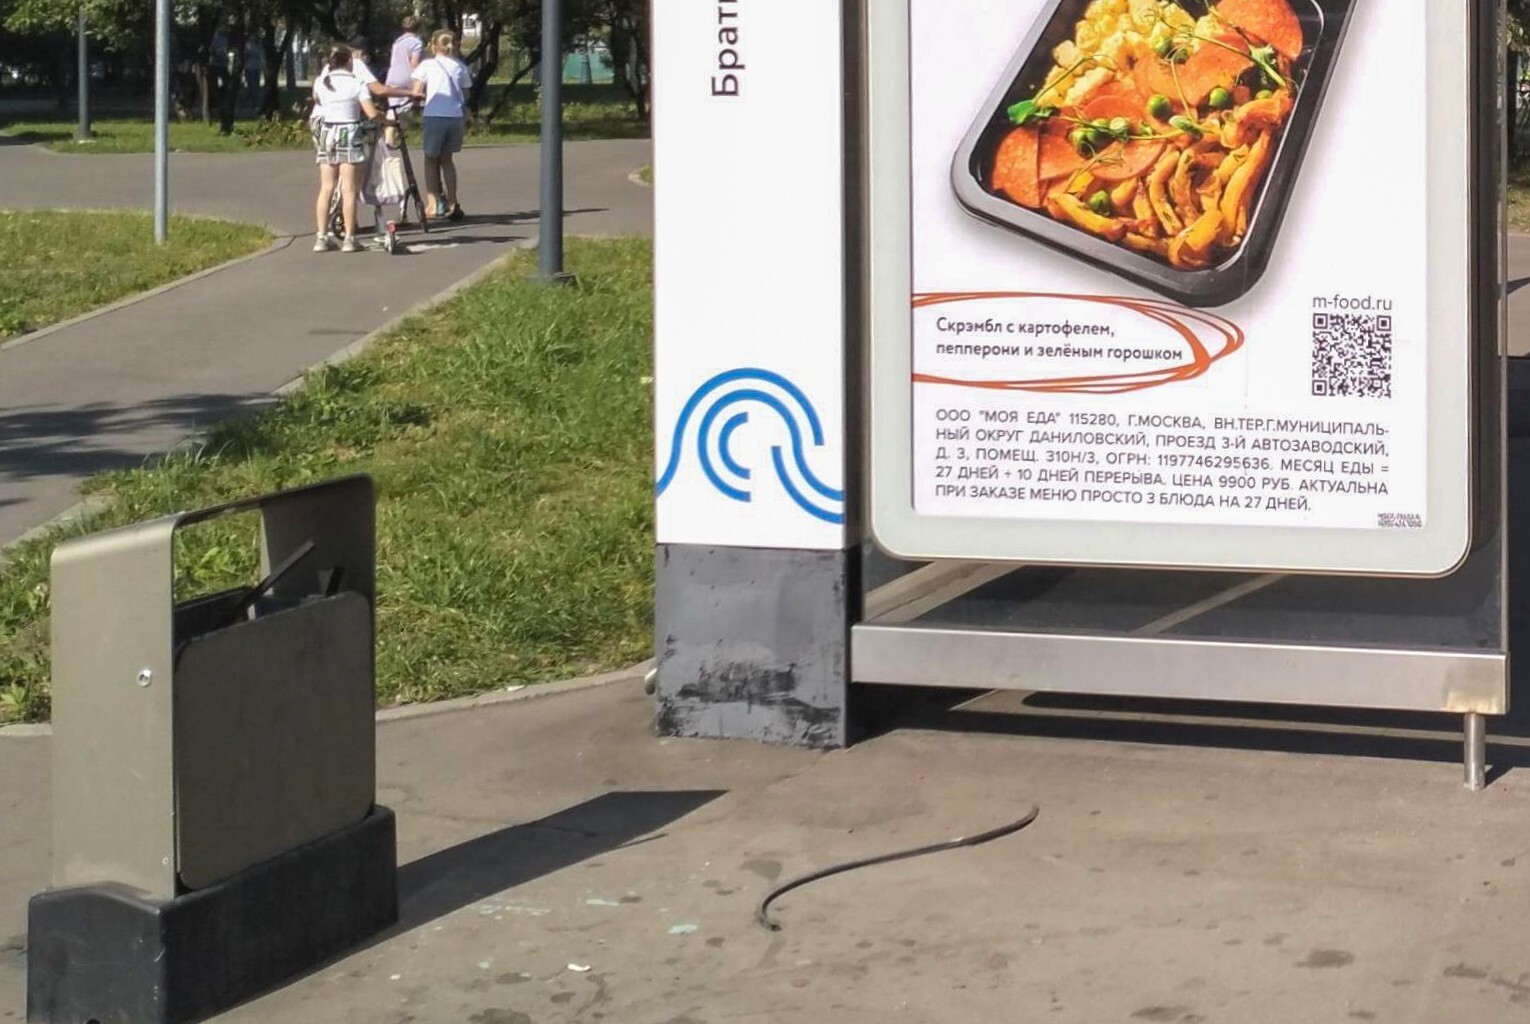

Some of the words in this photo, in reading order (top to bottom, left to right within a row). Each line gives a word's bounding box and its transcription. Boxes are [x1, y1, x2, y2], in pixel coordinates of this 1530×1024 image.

[1313, 295, 1393, 311] m-food.ru
[936, 317, 1003, 335] Скрэмбл
[1006, 323, 1015, 334] с
[1019, 321, 1115, 339] картофелем,
[936, 343, 1020, 359] пепперони
[1024, 345, 1033, 356] и
[1037, 341, 1104, 358] зелёным
[1107, 347, 1182, 363] горошком
[936, 409, 970, 422] ООО
[1069, 413, 1119, 427] 115280,
[936, 426, 970, 440] НЫЙ
[976, 429, 1024, 442] ОКРУГ
[1030, 430, 1150, 447] ДАНИЛОВСКИЙ,
[1155, 436, 1215, 450] ПРОЕЗД
[1251, 438, 1389, 456] АВТОЗАВОДСКИЙ,
[1106, 452, 1150, 465] ОГРН:
[1281, 459, 1334, 474] МЕСЯЦ
[1342, 463, 1374, 475] ЕДЫ
[936, 466, 952, 478] 27
[958, 466, 998, 480] ДНЕЙ
[1018, 469, 1032, 481] 10
[1038, 468, 1078, 482] ДНЕЙ
[1173, 475, 1213, 489] ЦЕНА
[1219, 476, 1256, 489] 9900
[1300, 480, 1388, 494] АКТУАЛЬНА
[936, 485, 966, 497] ПРИ
[970, 486, 1025, 499] ЗАКАЗЕ
[1030, 488, 1076, 501] МЕНЮ
[1081, 490, 1142, 504] ПРОСТО
[1147, 493, 1154, 504] 3
[1160, 493, 1214, 507] БЛЮДА
[1220, 495, 1239, 508] НА
[1245, 496, 1261, 508] 27
